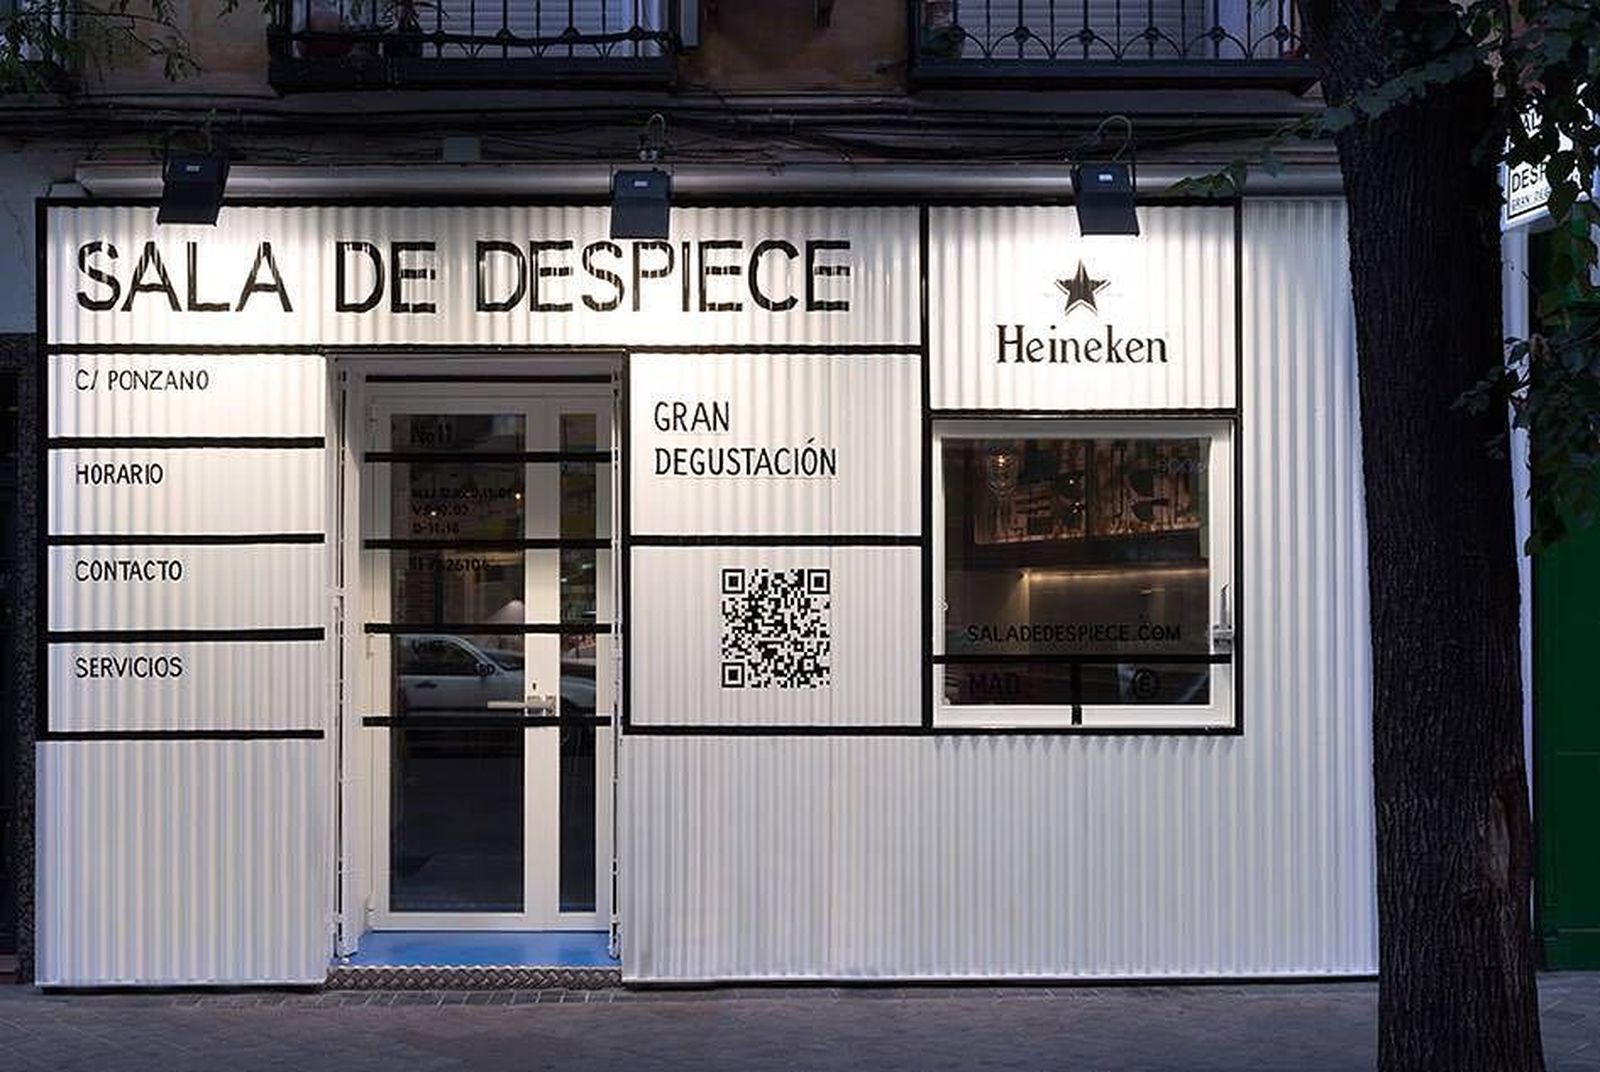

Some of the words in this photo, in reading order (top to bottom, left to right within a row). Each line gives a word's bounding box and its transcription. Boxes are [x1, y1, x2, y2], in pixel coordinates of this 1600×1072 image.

[75, 240, 293, 313] SALA
[335, 241, 436, 313] DE
[475, 240, 851, 313] DESPIECE
[996, 324, 1168, 363] Heineken
[75, 368, 98, 392] C/
[108, 369, 209, 391] PONZANO
[654, 401, 730, 432] GRAN
[654, 438, 837, 476] DEGUSTACIÓN
[75, 463, 164, 484] HORARIO
[75, 560, 183, 581] CONTACTO
[75, 656, 183, 678] SERVICIOS
